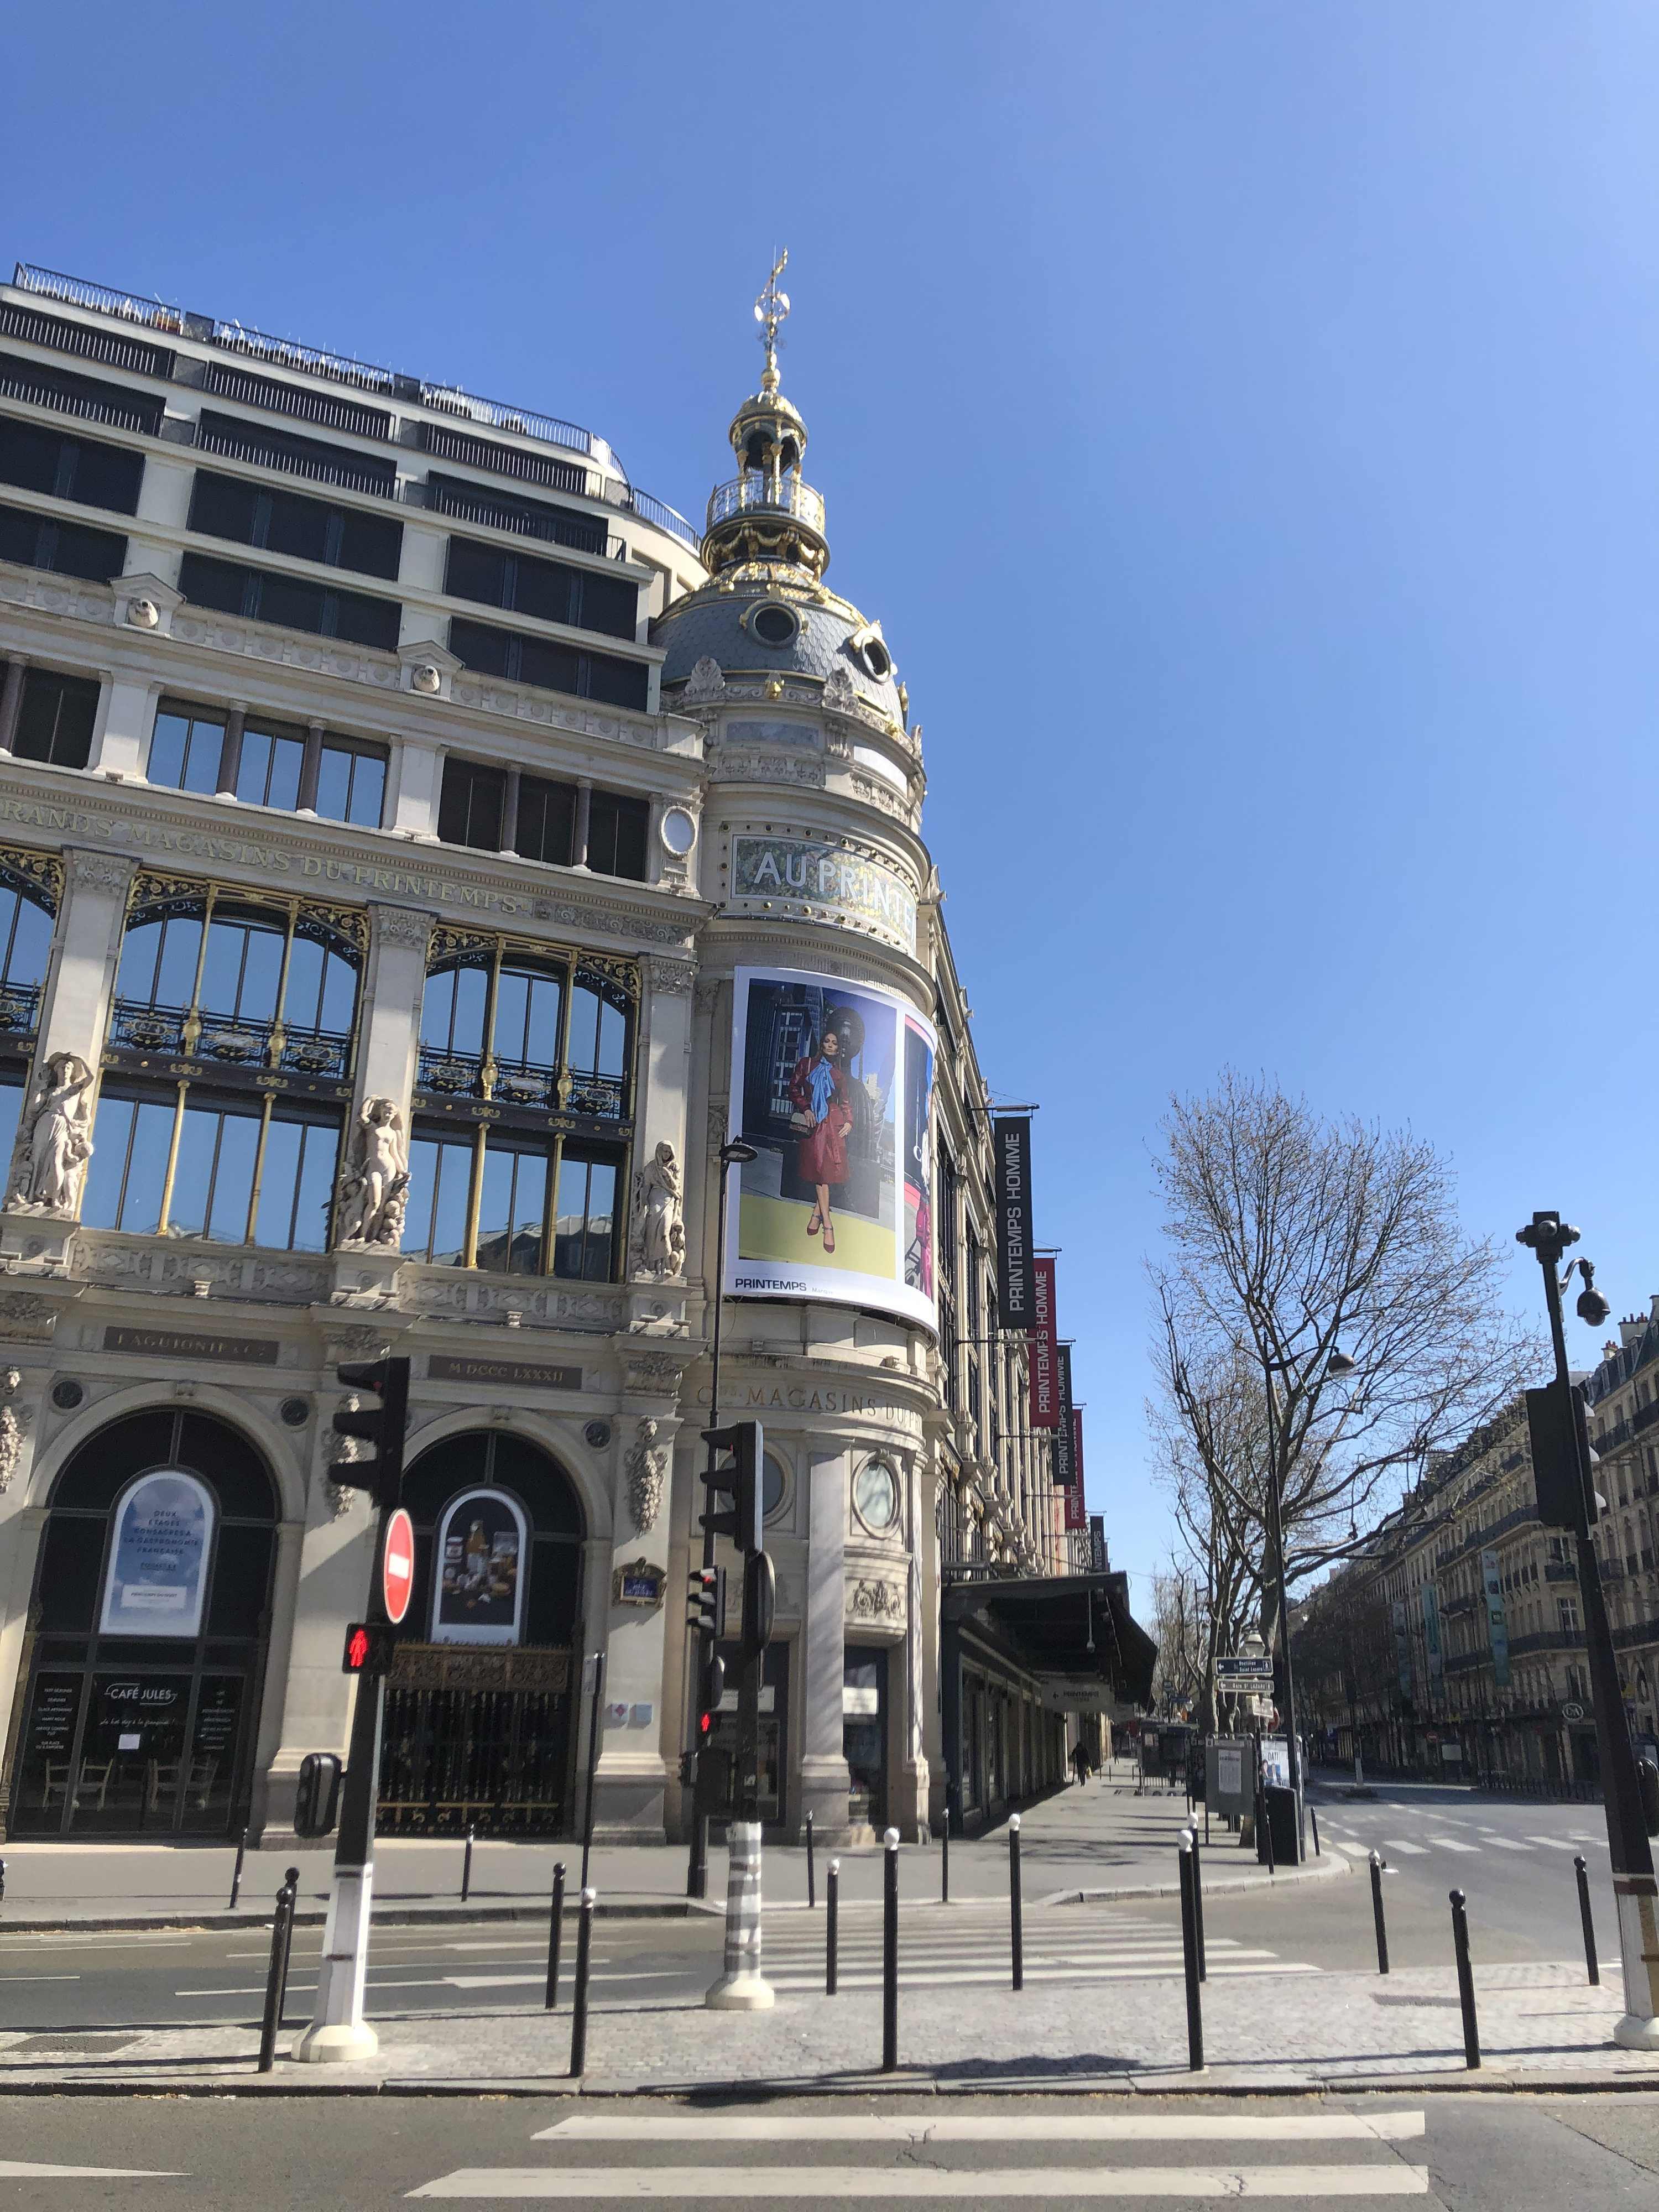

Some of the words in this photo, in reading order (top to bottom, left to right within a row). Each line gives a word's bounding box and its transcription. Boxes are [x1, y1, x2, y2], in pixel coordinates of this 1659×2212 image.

[1, 800, 112, 838] RANDS
[126, 823, 290, 872] MAGASINS
[302, 857, 342, 880] DU
[354, 866, 518, 914] PRINTEMPS
[754, 852, 807, 887] AU
[818, 859, 914, 937] PRINTE
[1005, 1132, 1021, 1200] HOMME
[735, 1278, 807, 1291] PRINTEMPS
[1006, 1206, 1024, 1312] PRINTEMPS
[1035, 1271, 1048, 1324] HOMME
[448, 1363, 461, 1373] M
[746, 1386, 876, 1416] MAGASINS
[886, 1403, 904, 1423] DU
[111, 1687, 139, 1699] CAFÉ
[140, 1689, 171, 1700] JULES
